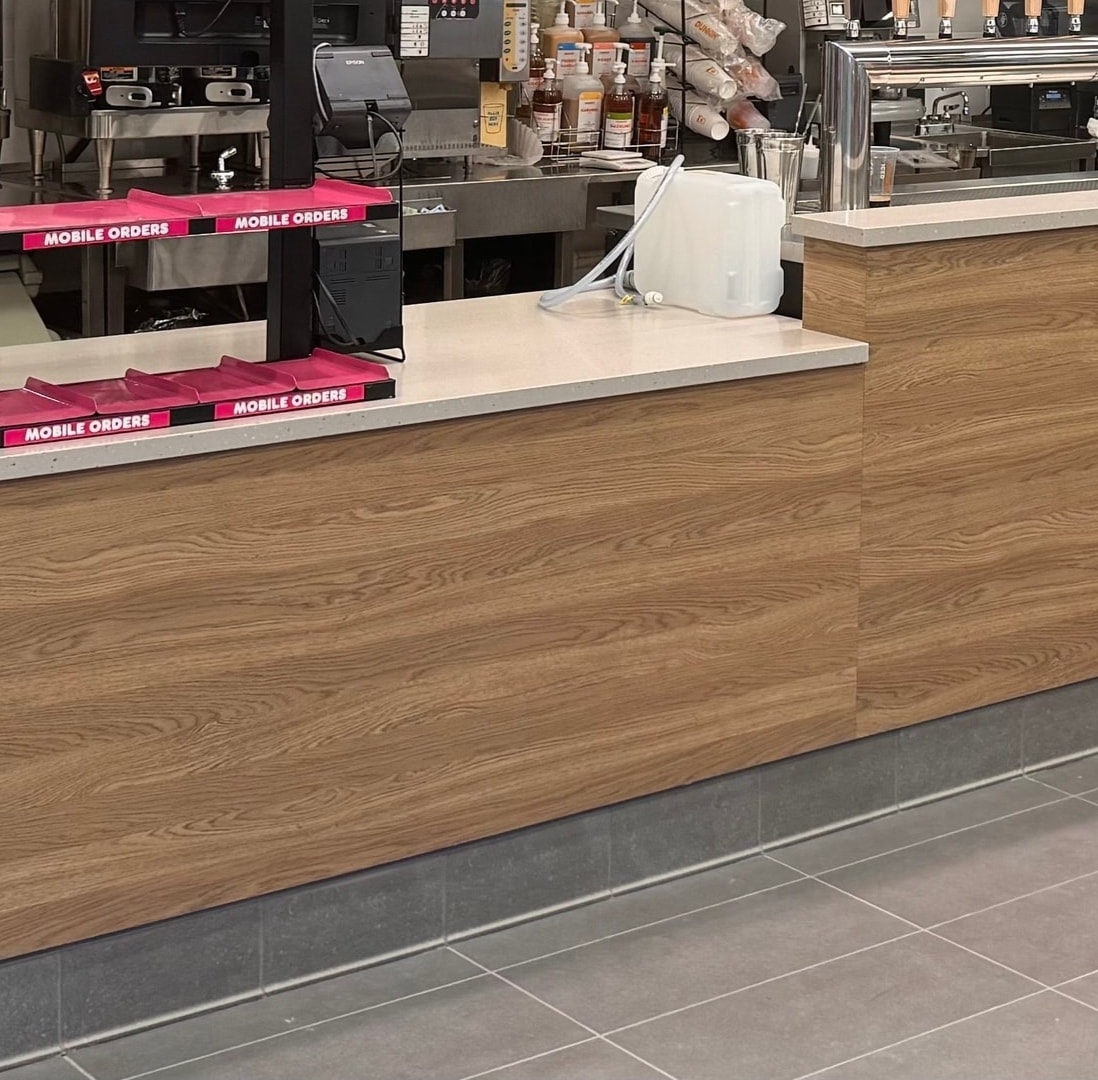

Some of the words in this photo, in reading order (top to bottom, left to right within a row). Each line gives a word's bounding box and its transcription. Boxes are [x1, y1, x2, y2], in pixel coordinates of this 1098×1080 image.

[235, 213, 289, 229] MOBILE
[293, 209, 348, 224] ORDERS
[44, 229, 104, 246] MOBILE
[108, 222, 169, 240] ORDERS
[234, 398, 288, 415] MOBILE
[292, 389, 347, 407] ORDERS
[25, 424, 85, 441] MOBILE
[89, 415, 150, 433] ORDERS
